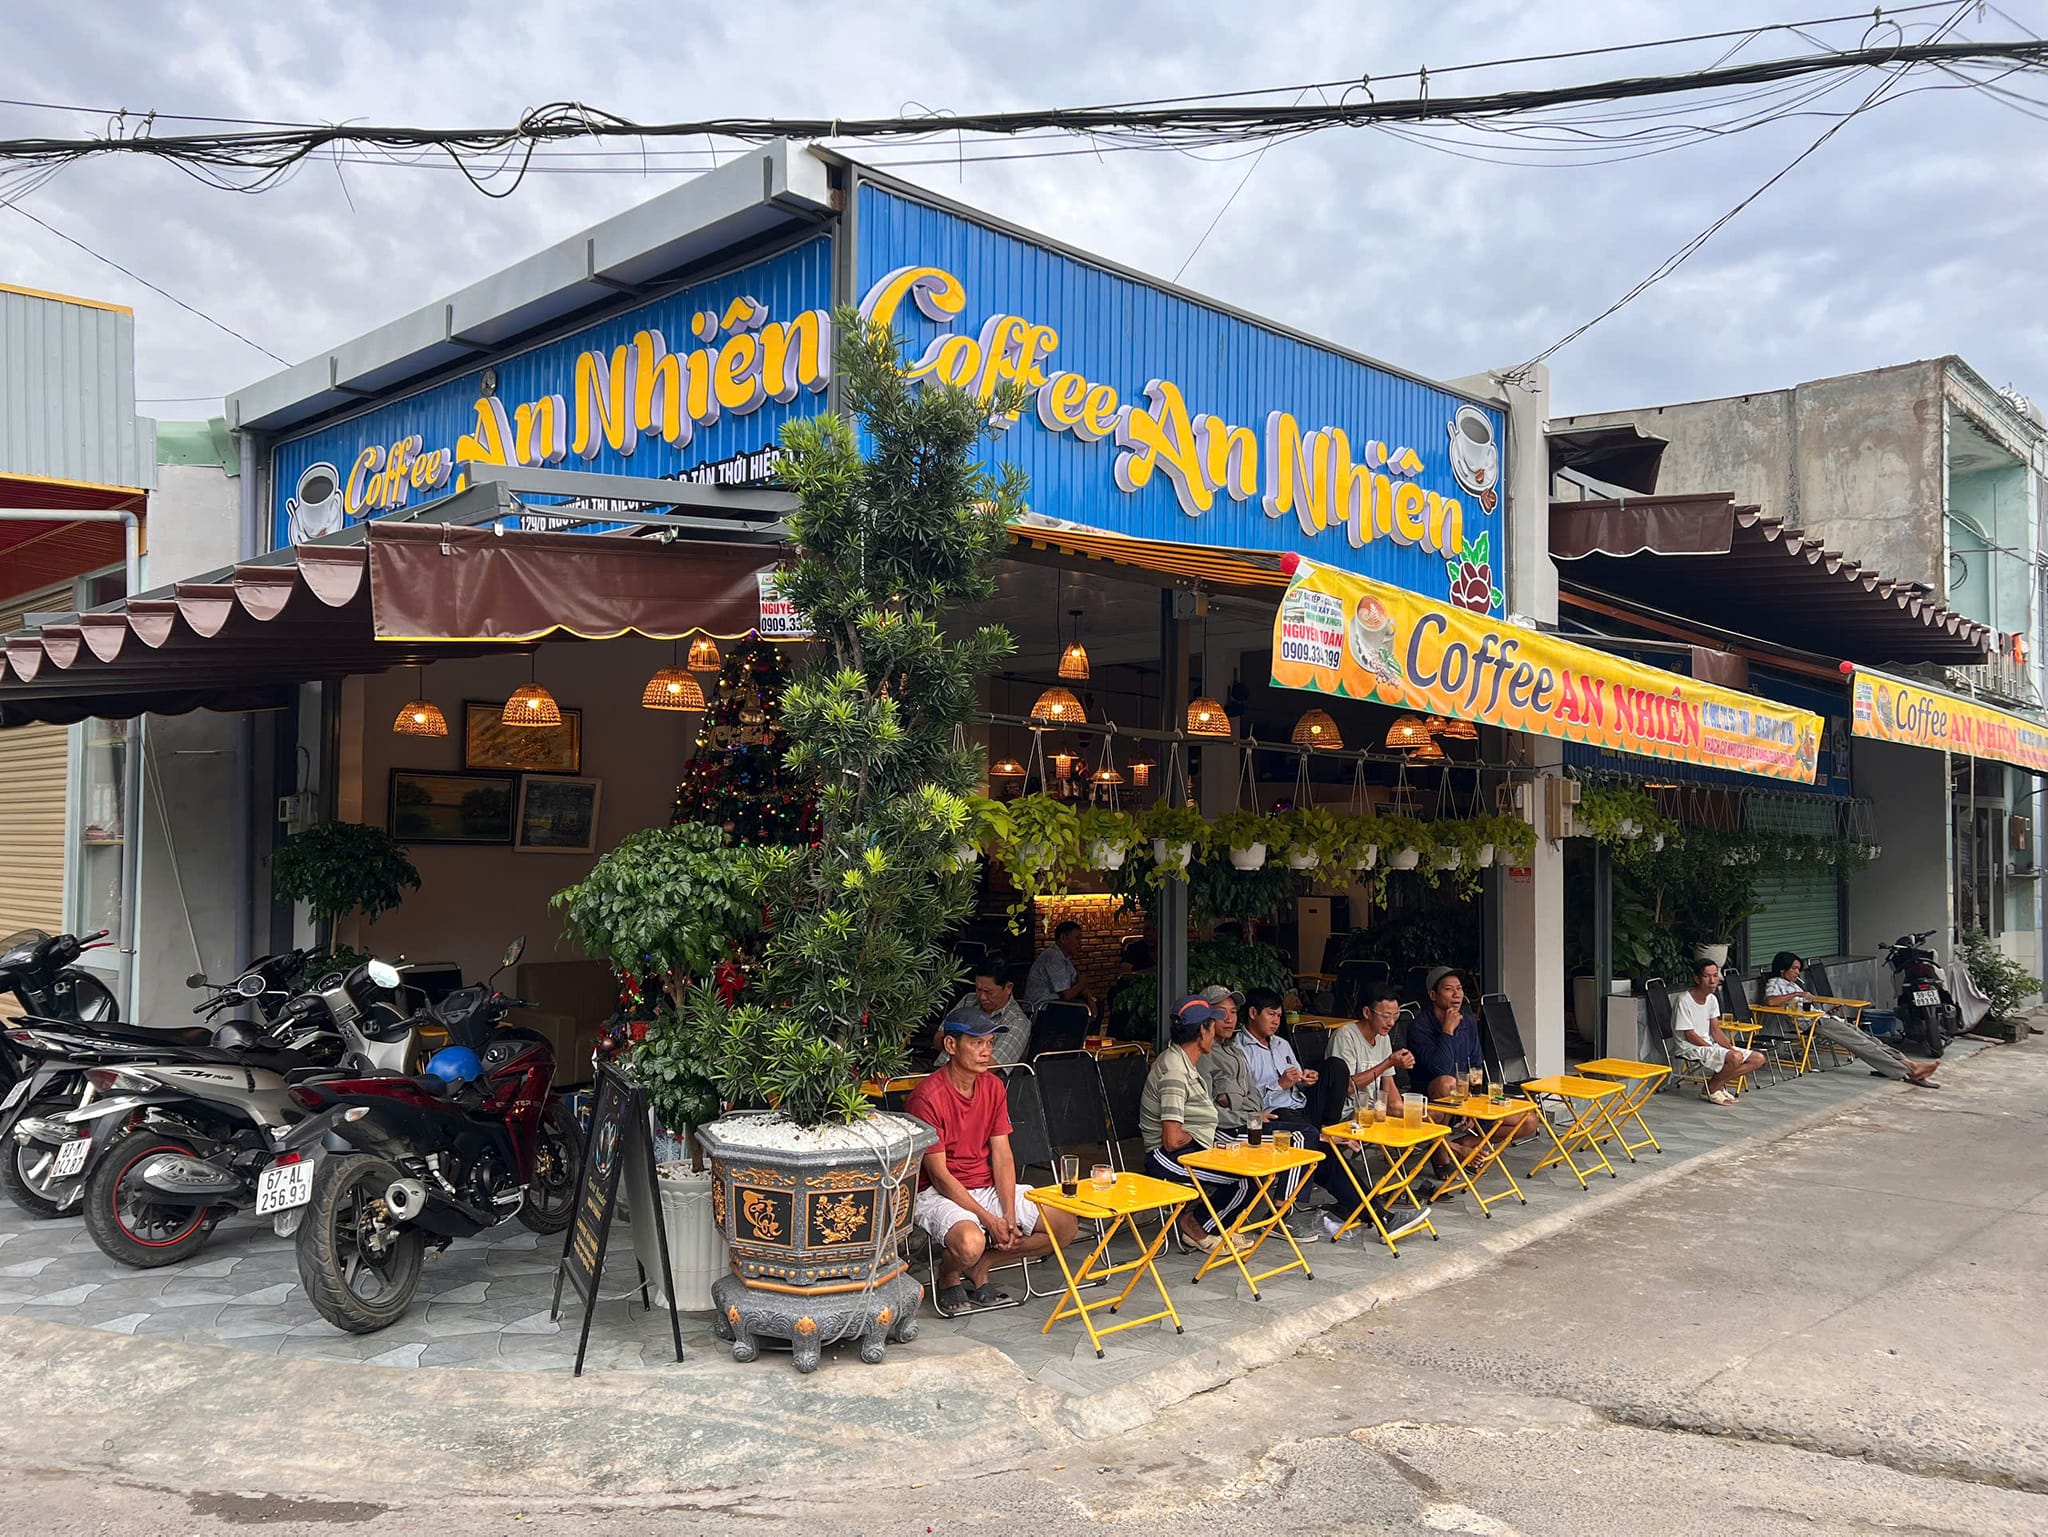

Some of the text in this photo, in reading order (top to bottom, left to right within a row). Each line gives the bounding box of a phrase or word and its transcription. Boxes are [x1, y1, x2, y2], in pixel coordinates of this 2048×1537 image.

[345, 296, 830, 516] Coffee An Nhiên
[862, 266, 1463, 558] Coffee An Nhiên
[1406, 613, 1554, 714] Coffee
[1554, 670, 1605, 729] AN
[1613, 686, 1700, 747] NHIÊN
[1896, 690, 1948, 740] Coffee
[1950, 712, 1972, 744] AN
[261, 1184, 306, 1211] 256.93
[267, 1166, 303, 1190] 67-AL
